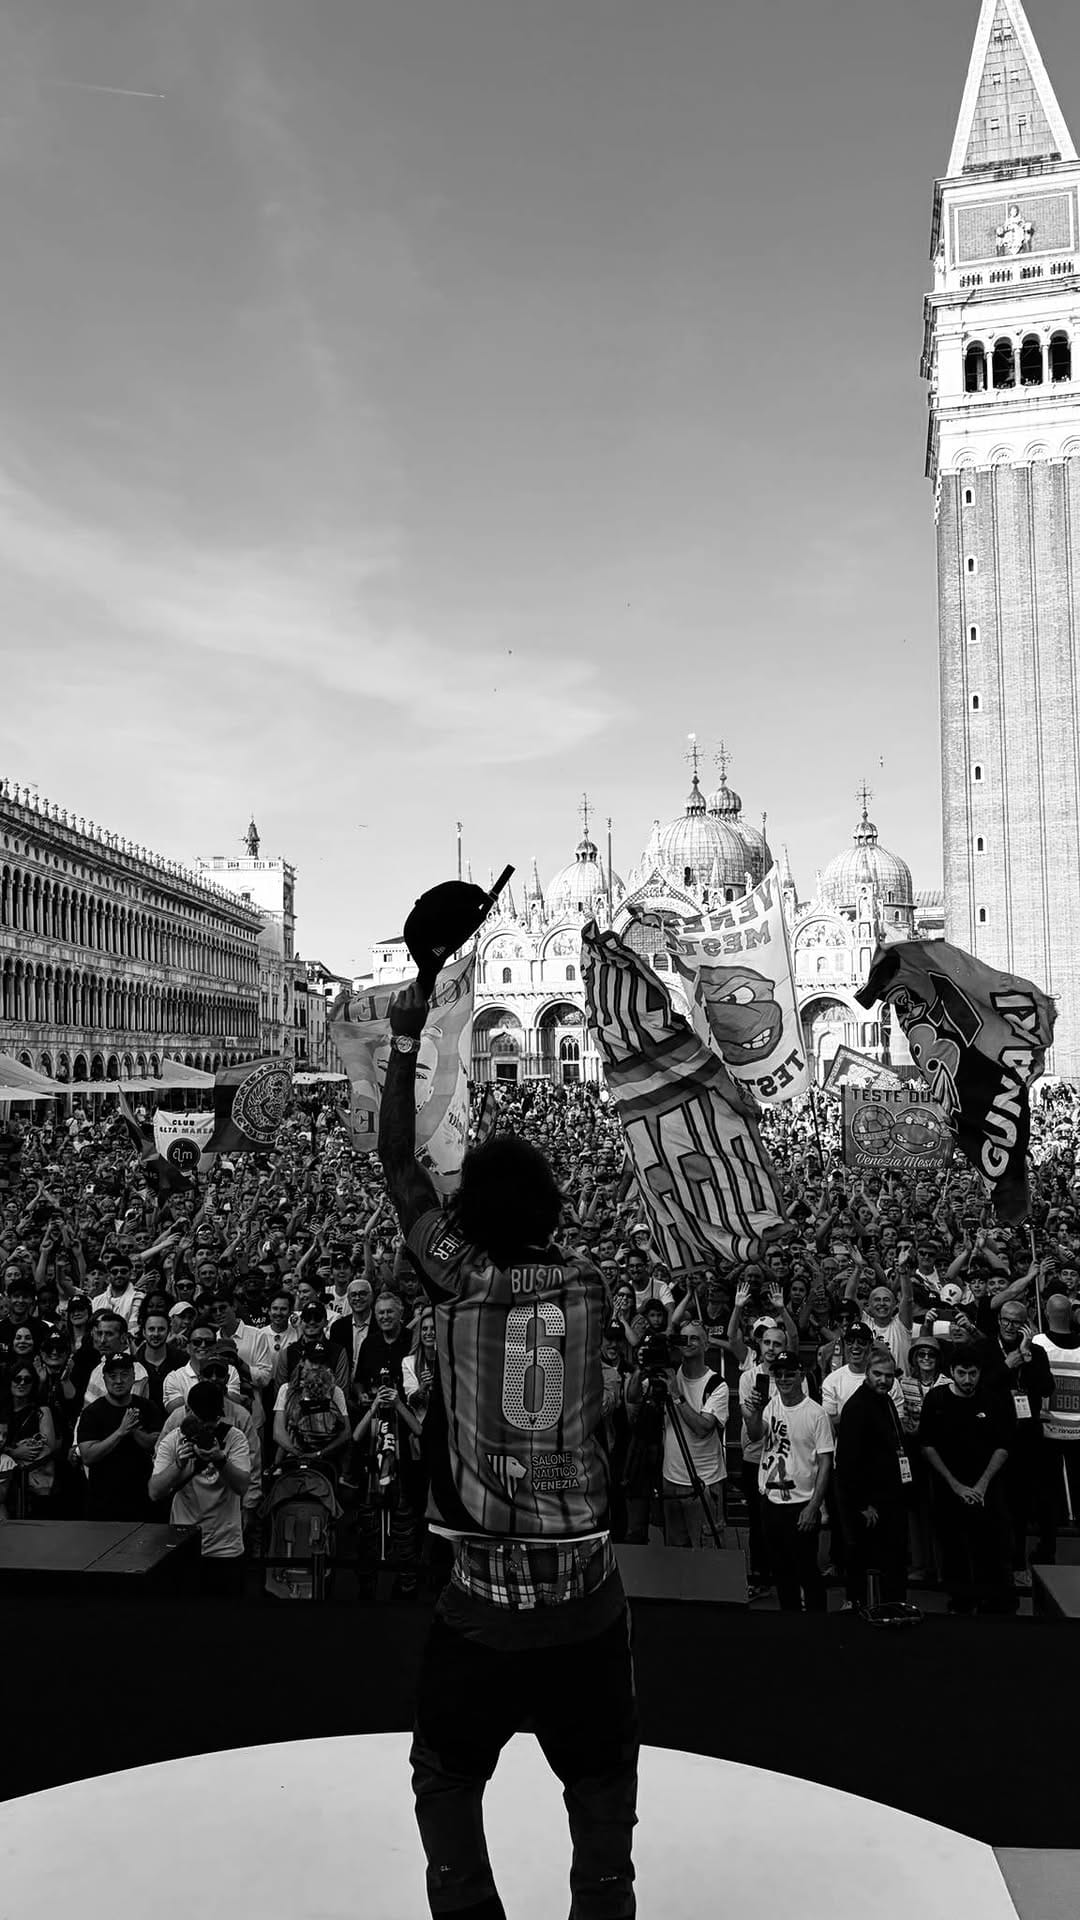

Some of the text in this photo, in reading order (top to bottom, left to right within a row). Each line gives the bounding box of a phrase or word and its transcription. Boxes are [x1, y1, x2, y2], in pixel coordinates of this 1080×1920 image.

[852, 1088, 933, 1103] TESTE DU
[855, 1153, 943, 1167] Venezia Mestre
[433, 1233, 462, 1260] HER
[501, 1301, 565, 1431] 6
[532, 1453, 572, 1466] SALONE
[532, 1465, 577, 1478] NAUTICO
[532, 1479, 580, 1490] VENEZIA
